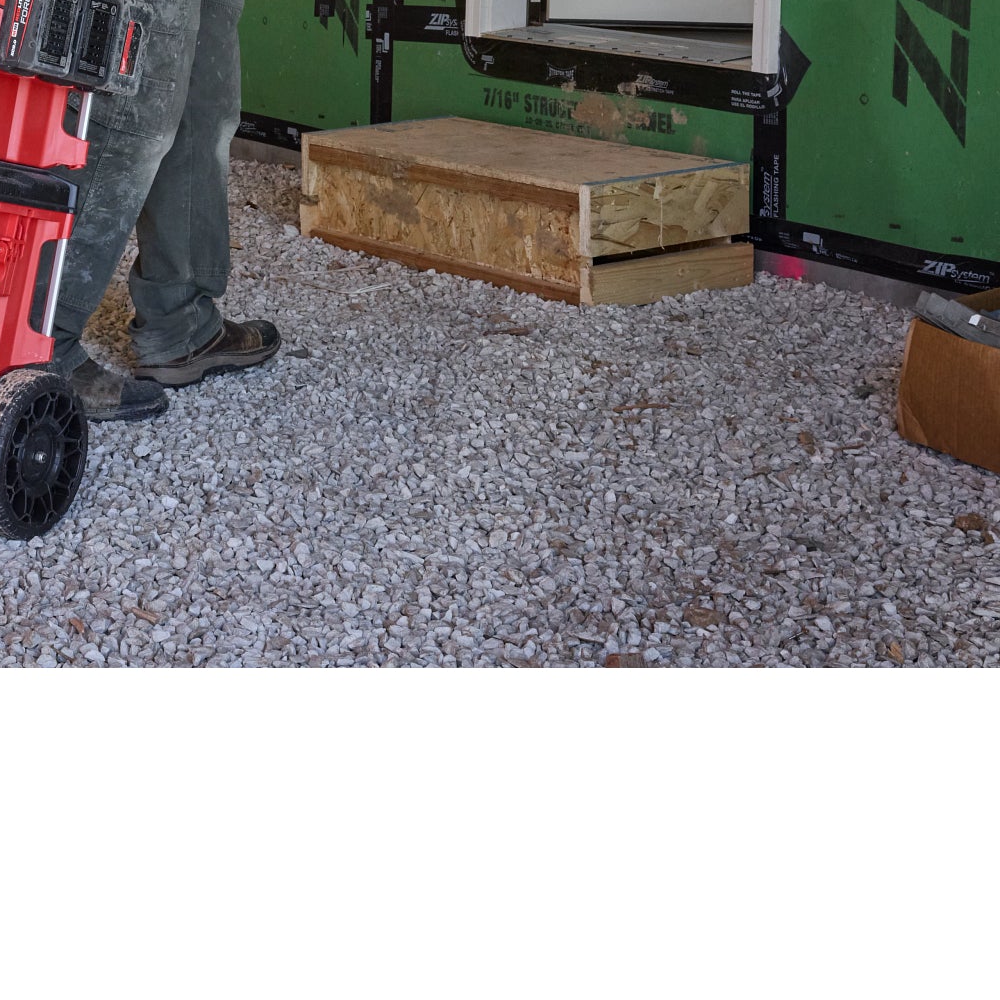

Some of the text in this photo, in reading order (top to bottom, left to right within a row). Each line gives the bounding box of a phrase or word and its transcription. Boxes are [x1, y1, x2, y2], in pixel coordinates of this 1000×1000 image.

[483, 87, 519, 110] 7/16"
[772, 154, 780, 218] FLASHING TAPE
